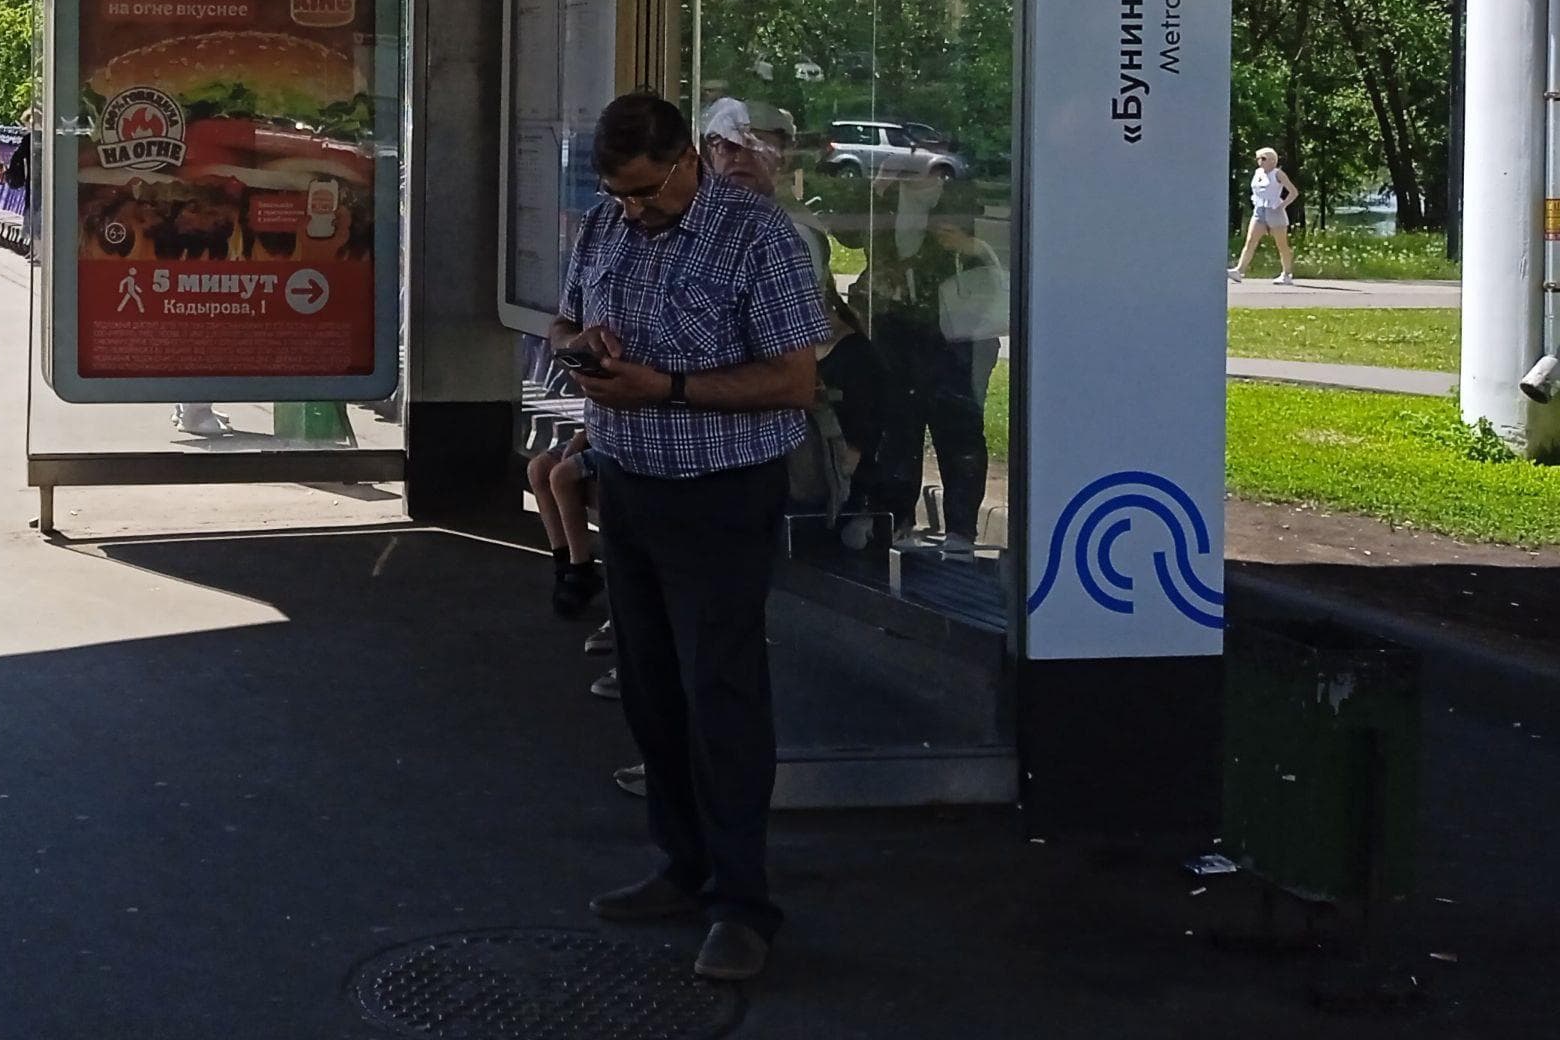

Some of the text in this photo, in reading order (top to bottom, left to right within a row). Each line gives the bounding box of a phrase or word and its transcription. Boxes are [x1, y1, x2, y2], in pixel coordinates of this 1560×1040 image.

[108, 3, 249, 19] на огне вкуснее
[102, 141, 183, 164] НА ОГНЕ
[109, 227, 125, 239] 6+
[152, 268, 278, 300] 5 минут
[163, 299, 266, 317] Кадырова, 1
